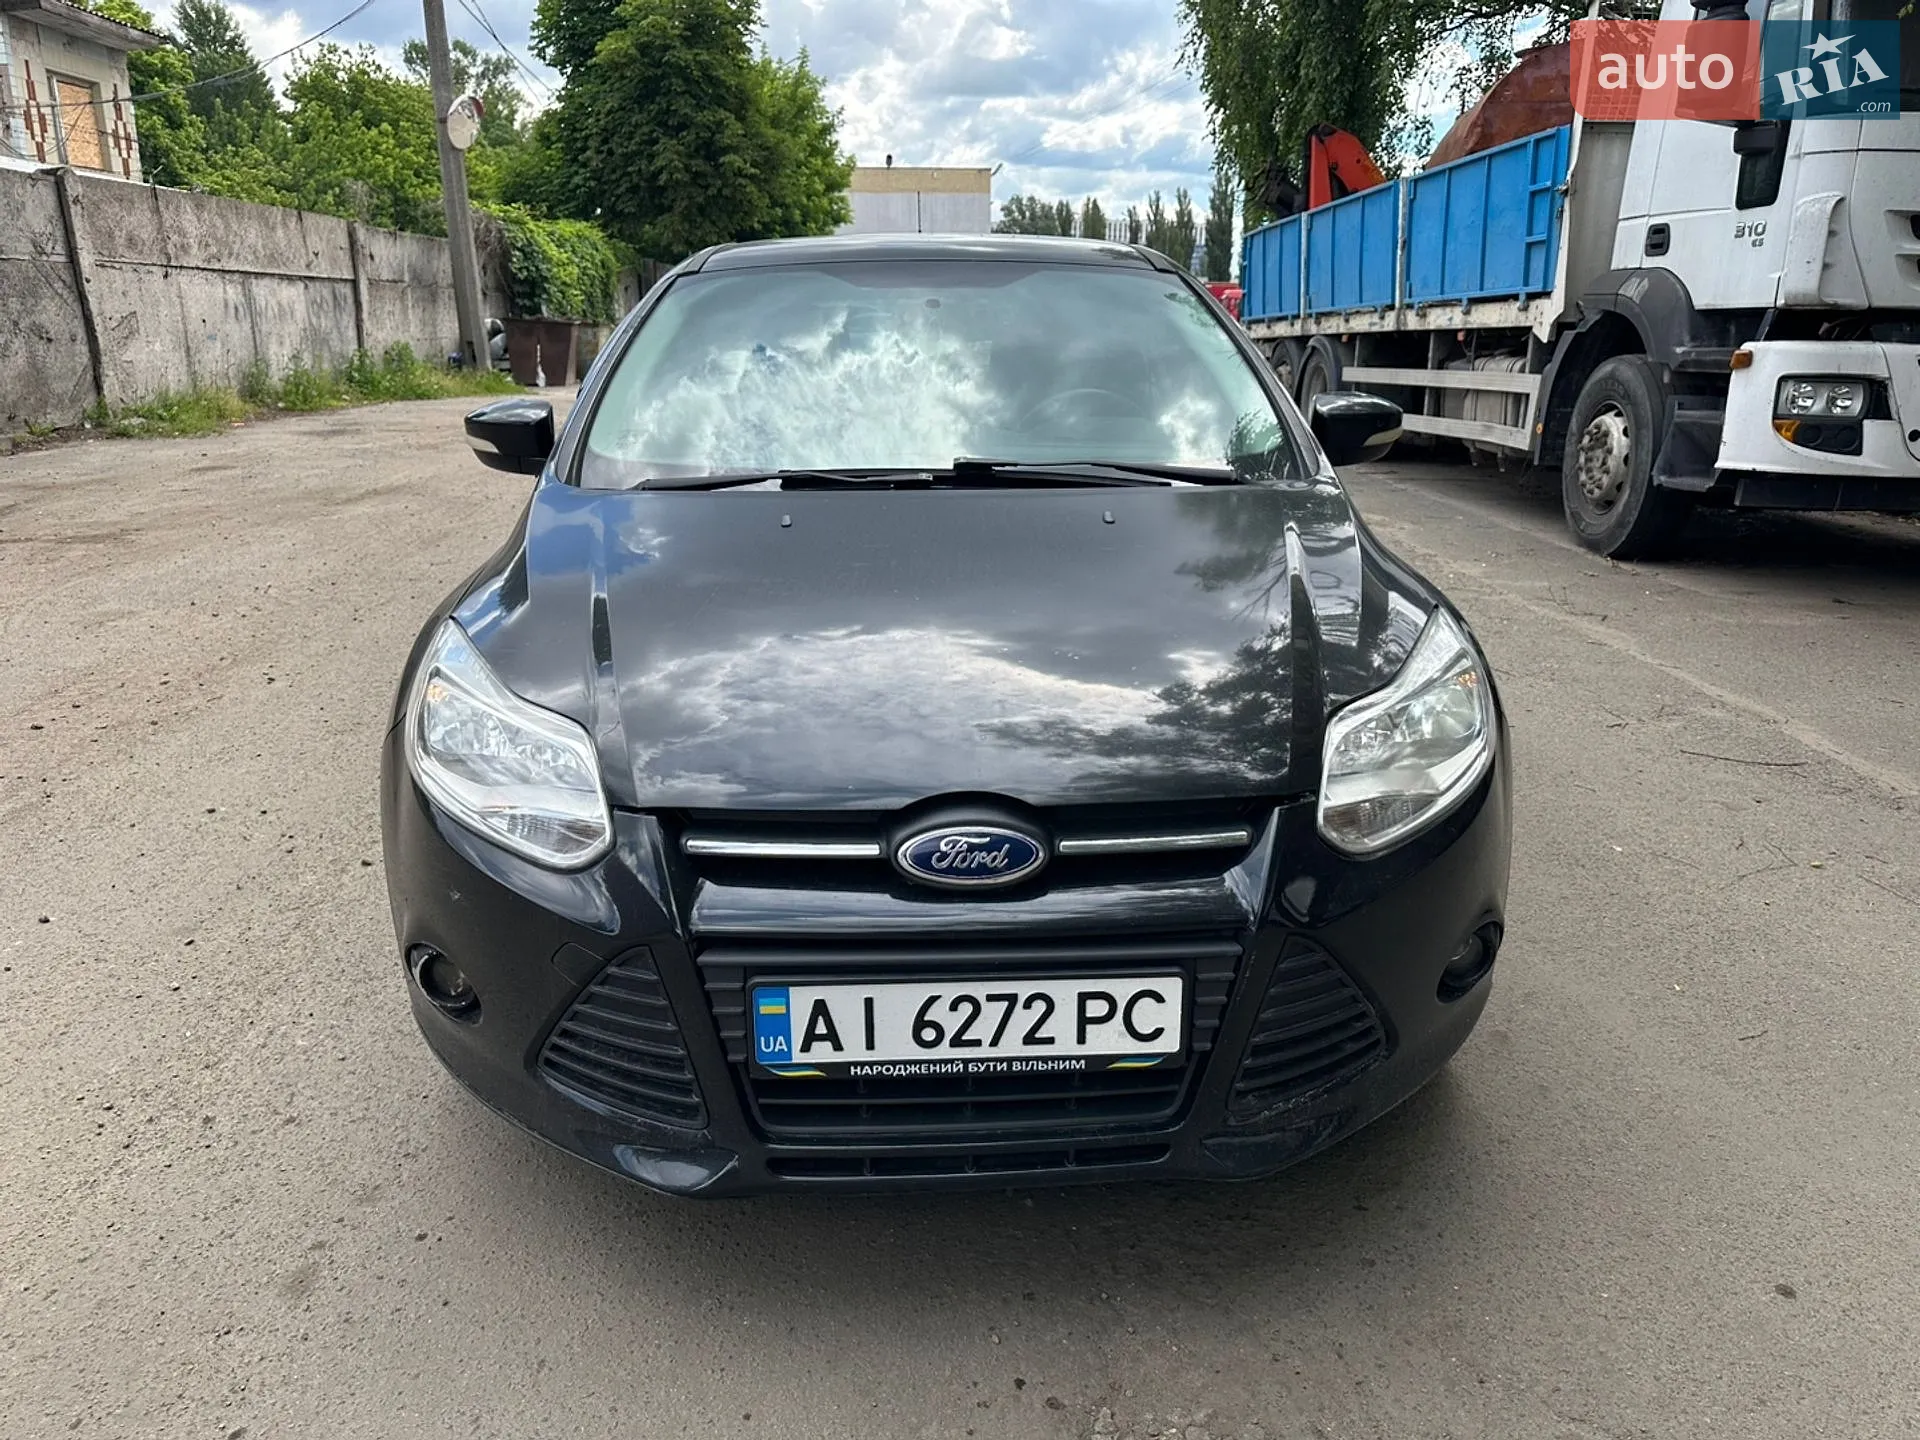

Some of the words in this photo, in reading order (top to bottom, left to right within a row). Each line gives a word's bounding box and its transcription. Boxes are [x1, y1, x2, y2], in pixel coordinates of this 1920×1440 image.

[1734, 220, 1767, 239] 310
[931, 835, 1010, 869] Ford
[911, 992, 1056, 1050] 6272
[1076, 989, 1166, 1045] PC
[760, 1035, 788, 1053] UA
[850, 1060, 963, 1077] НАРОДЖЕНИЙ
[968, 1060, 1008, 1073] БУТИ
[1012, 1058, 1086, 1071] ВІЛЬНИМ
